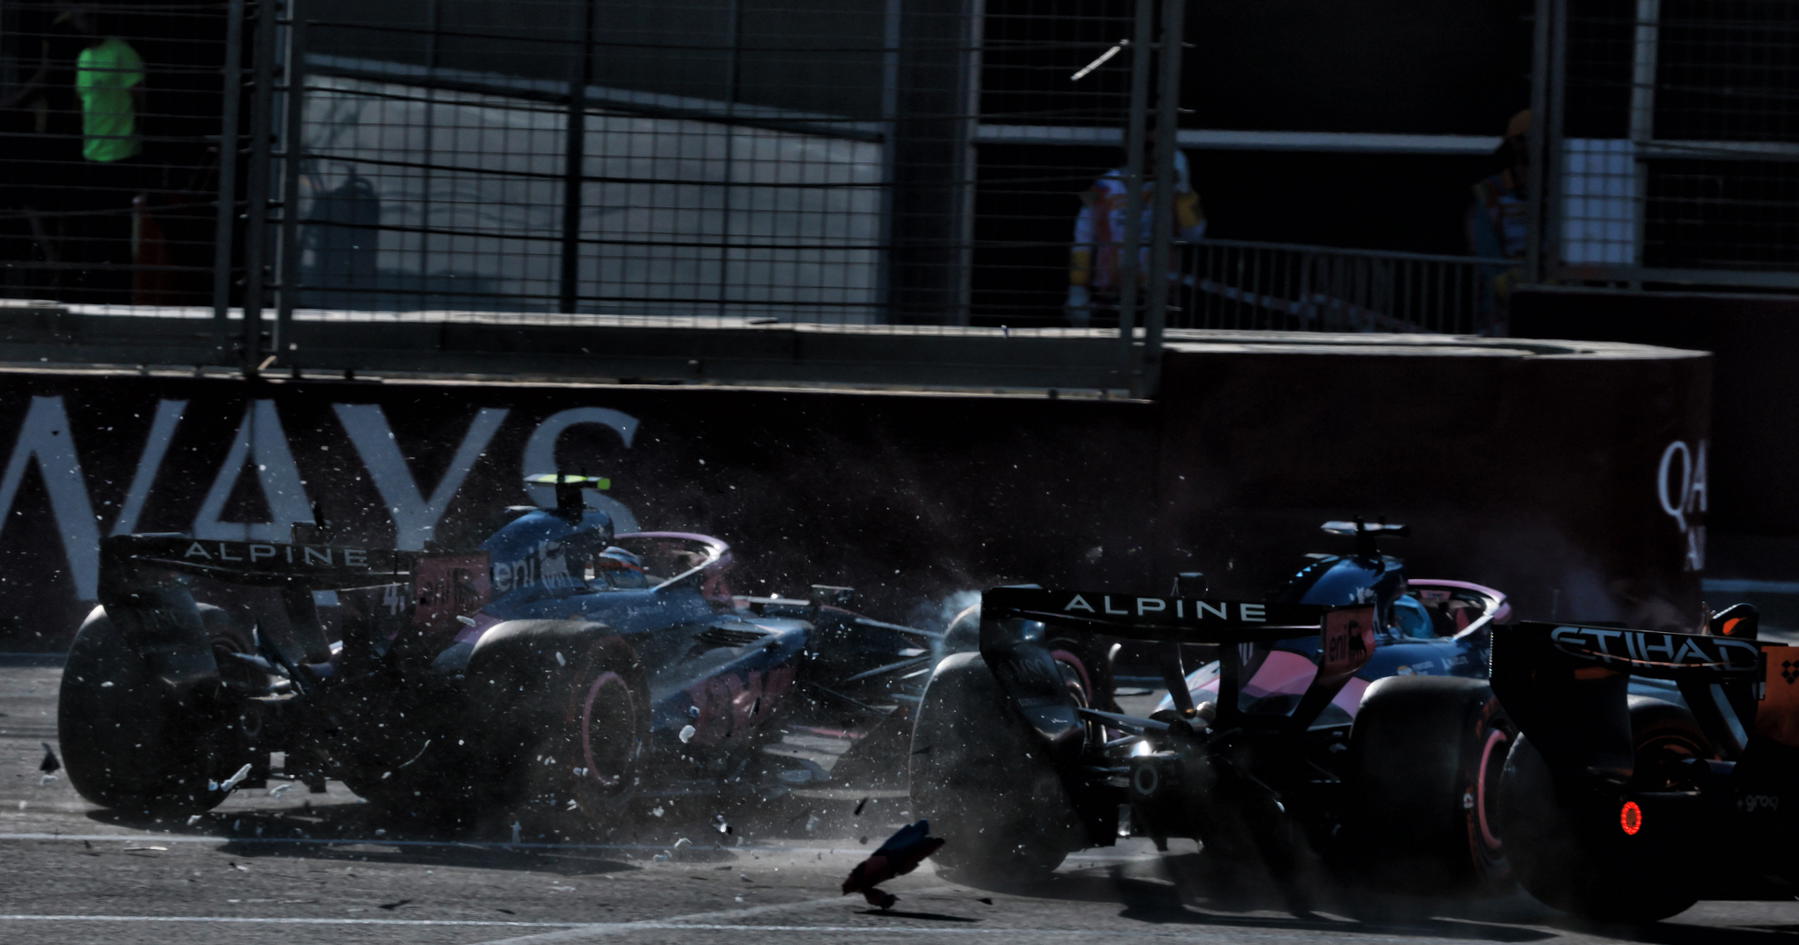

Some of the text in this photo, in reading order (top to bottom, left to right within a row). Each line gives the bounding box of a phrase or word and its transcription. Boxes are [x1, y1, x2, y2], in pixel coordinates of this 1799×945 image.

[184, 541, 369, 567] ALPINE
[493, 547, 535, 592] eni
[1064, 593, 1267, 622] ALPINE
[1329, 625, 1347, 662] eni
[1551, 626, 1760, 671] ETIHAD
